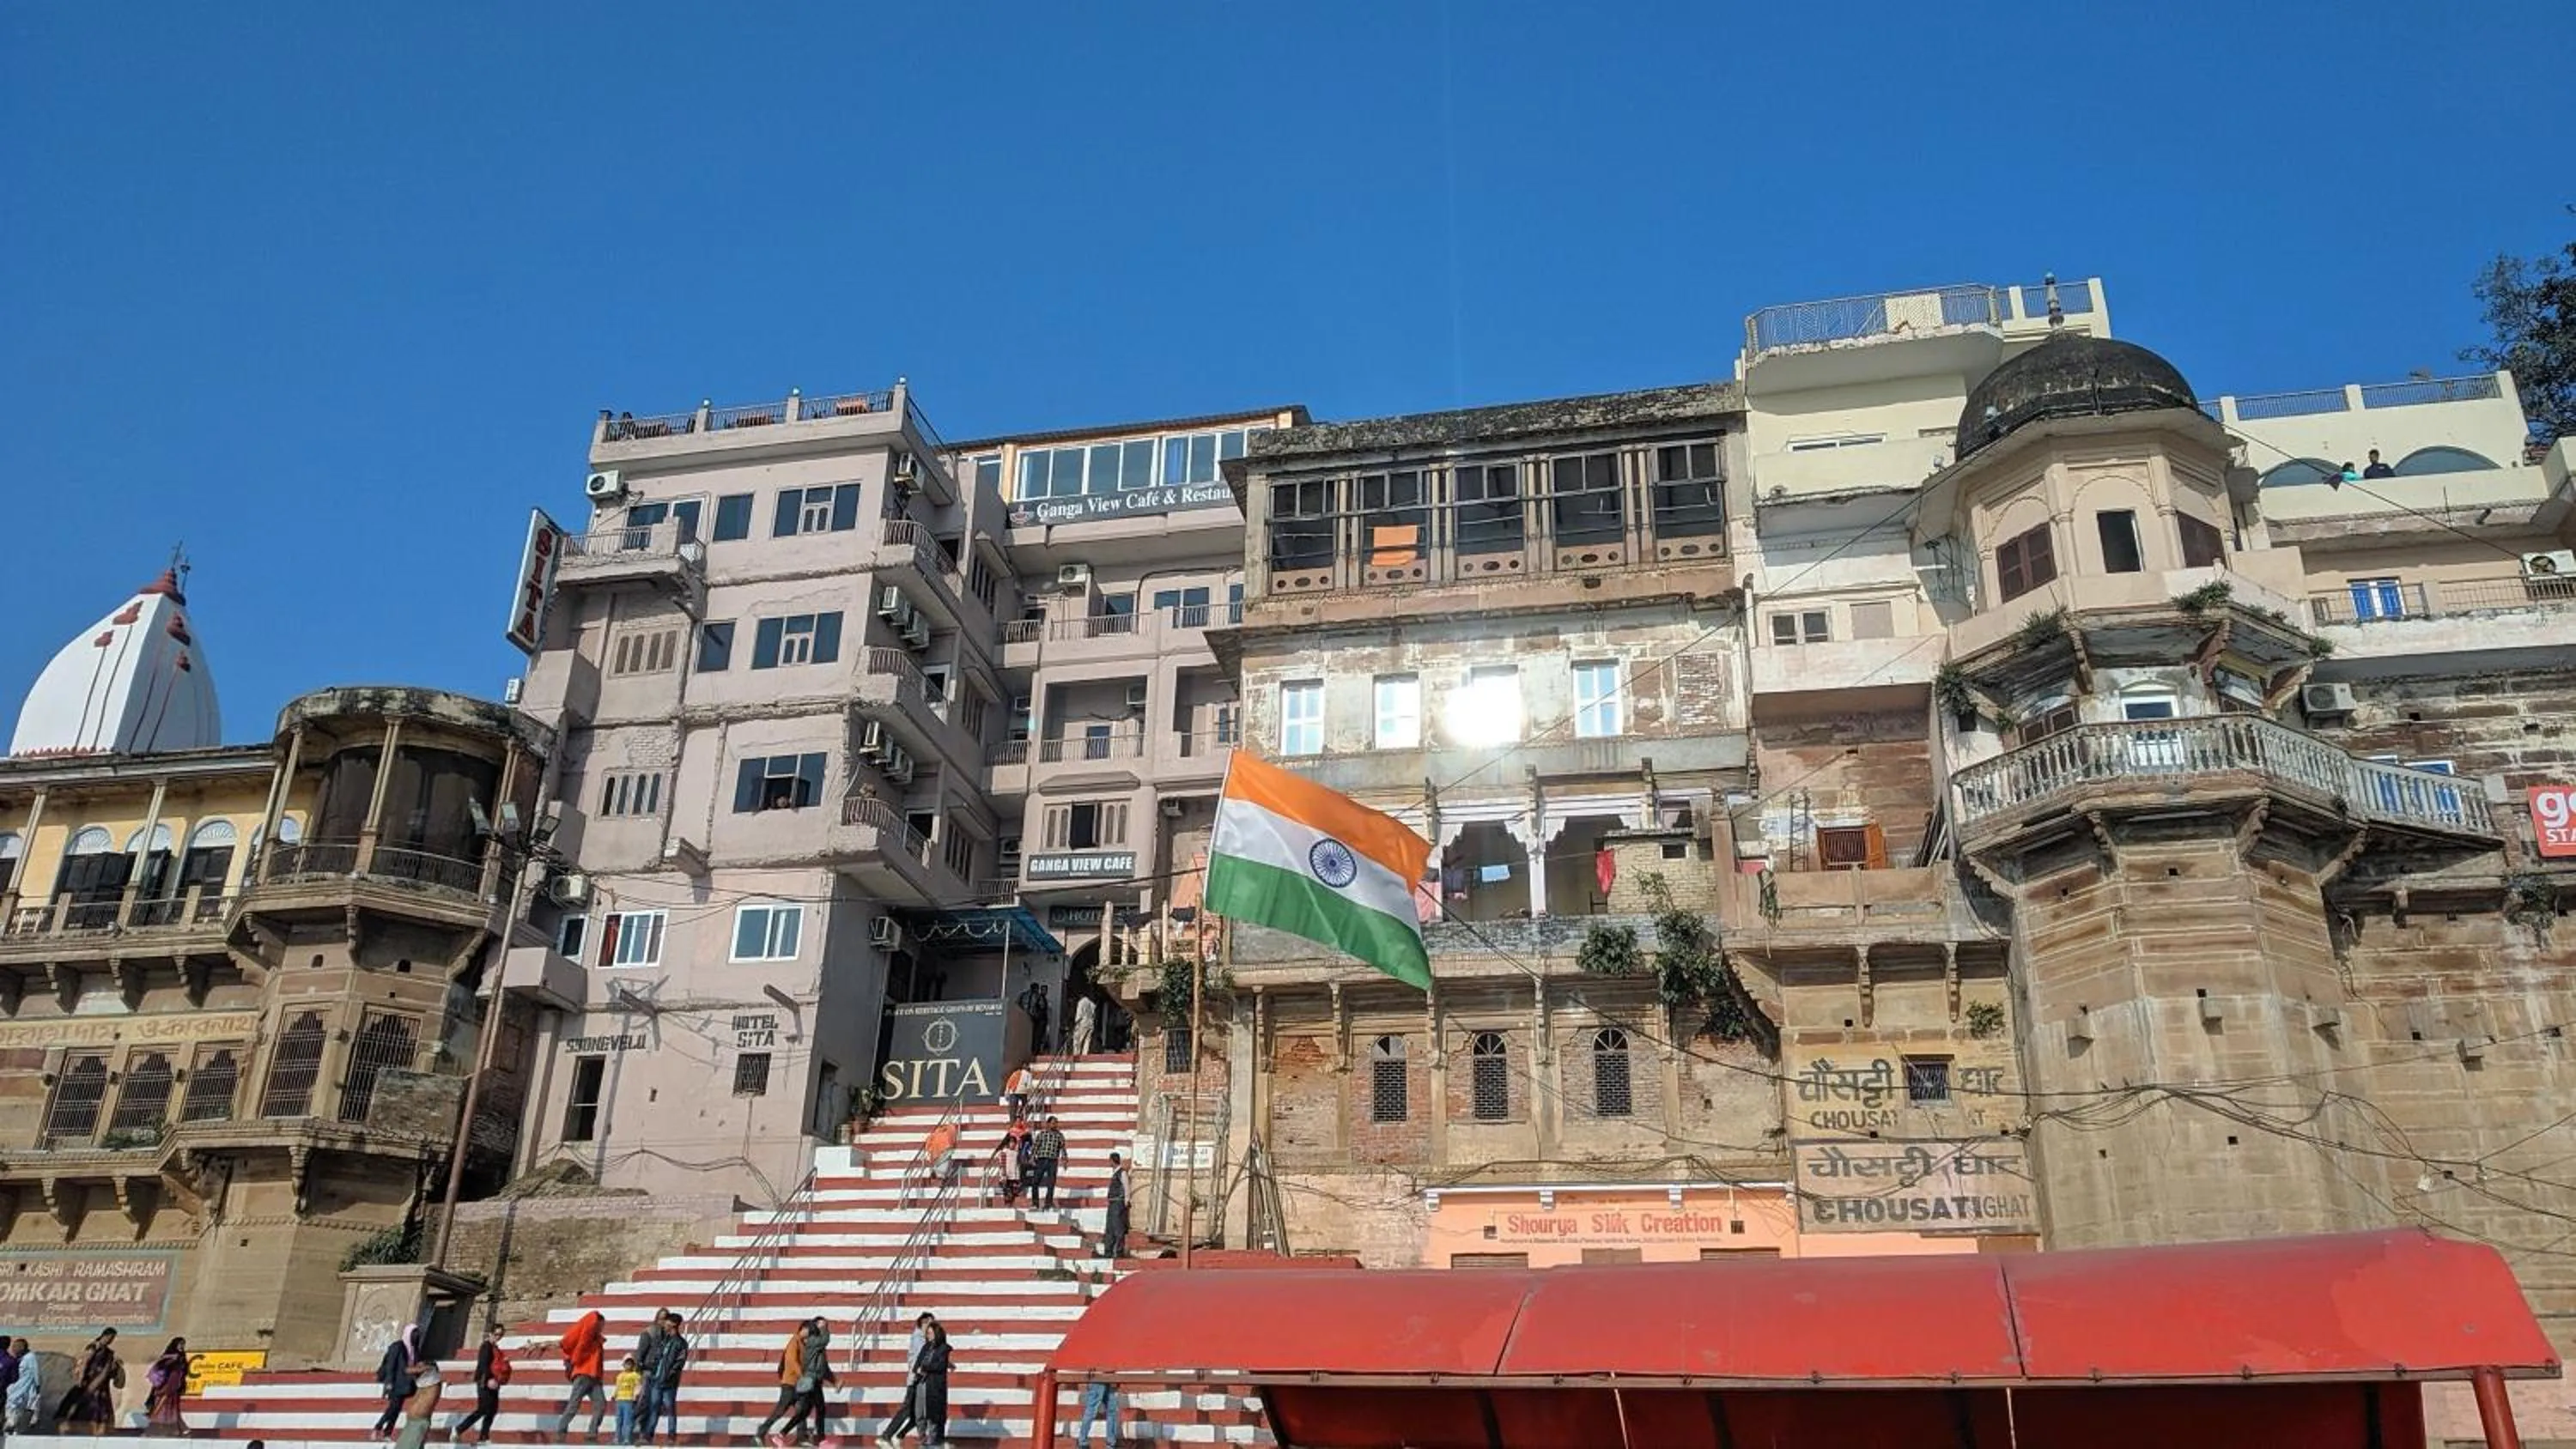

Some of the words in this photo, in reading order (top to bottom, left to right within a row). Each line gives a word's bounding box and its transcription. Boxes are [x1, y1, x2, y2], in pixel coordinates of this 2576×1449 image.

[1036, 503, 1083, 518] Ganga
[1088, 498, 1121, 512] View
[1126, 490, 1159, 508] Café
[1163, 489, 1176, 504] &
[1181, 486, 1233, 502] Restau
[517, 528, 552, 643] SITA
[1030, 858, 1069, 871] GANGA
[1071, 858, 1102, 870] VIEW
[1103, 857, 1133, 870] CAFE
[732, 1014, 779, 1030] HOTEL
[737, 1030, 775, 1048] SITA
[878, 1057, 992, 1100] SITA
[1507, 1214, 1577, 1236] Shourya
[1591, 1212, 1630, 1234] Silk
[1641, 1211, 1722, 1234] Creation
[25, 1261, 64, 1278] KASHI
[72, 1260, 167, 1278] RAMASHRAM
[85, 1281, 150, 1303] GHAT
